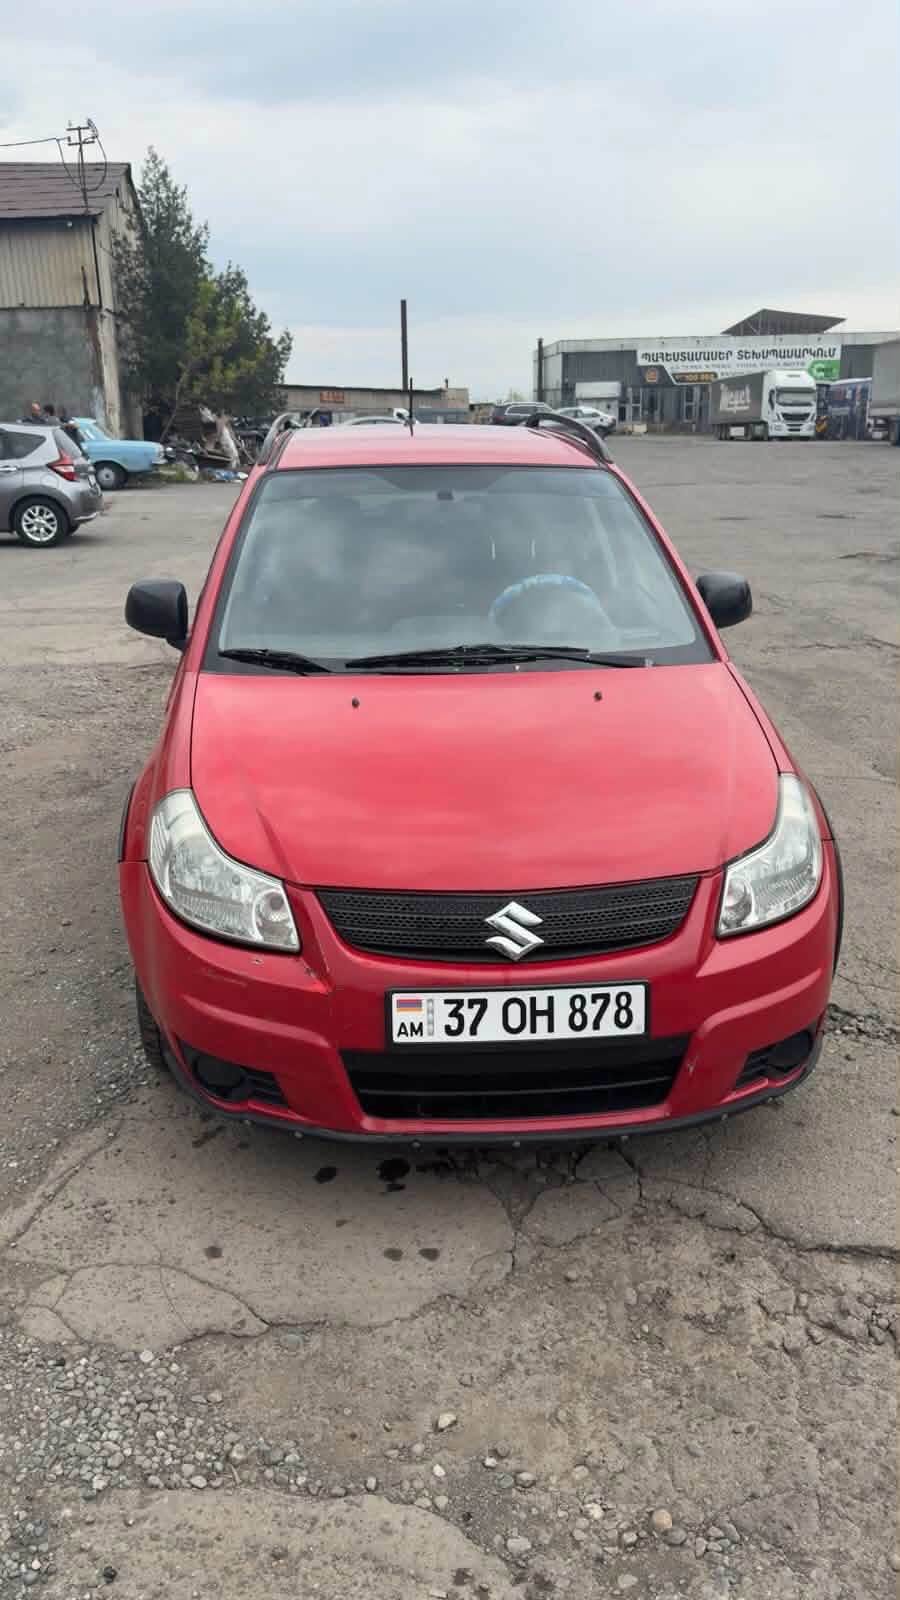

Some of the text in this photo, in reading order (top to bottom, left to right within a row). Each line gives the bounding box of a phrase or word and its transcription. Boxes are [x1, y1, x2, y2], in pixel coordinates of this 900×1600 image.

[443, 991, 634, 1036] 37 OH 878
[397, 1022, 424, 1038] AM
